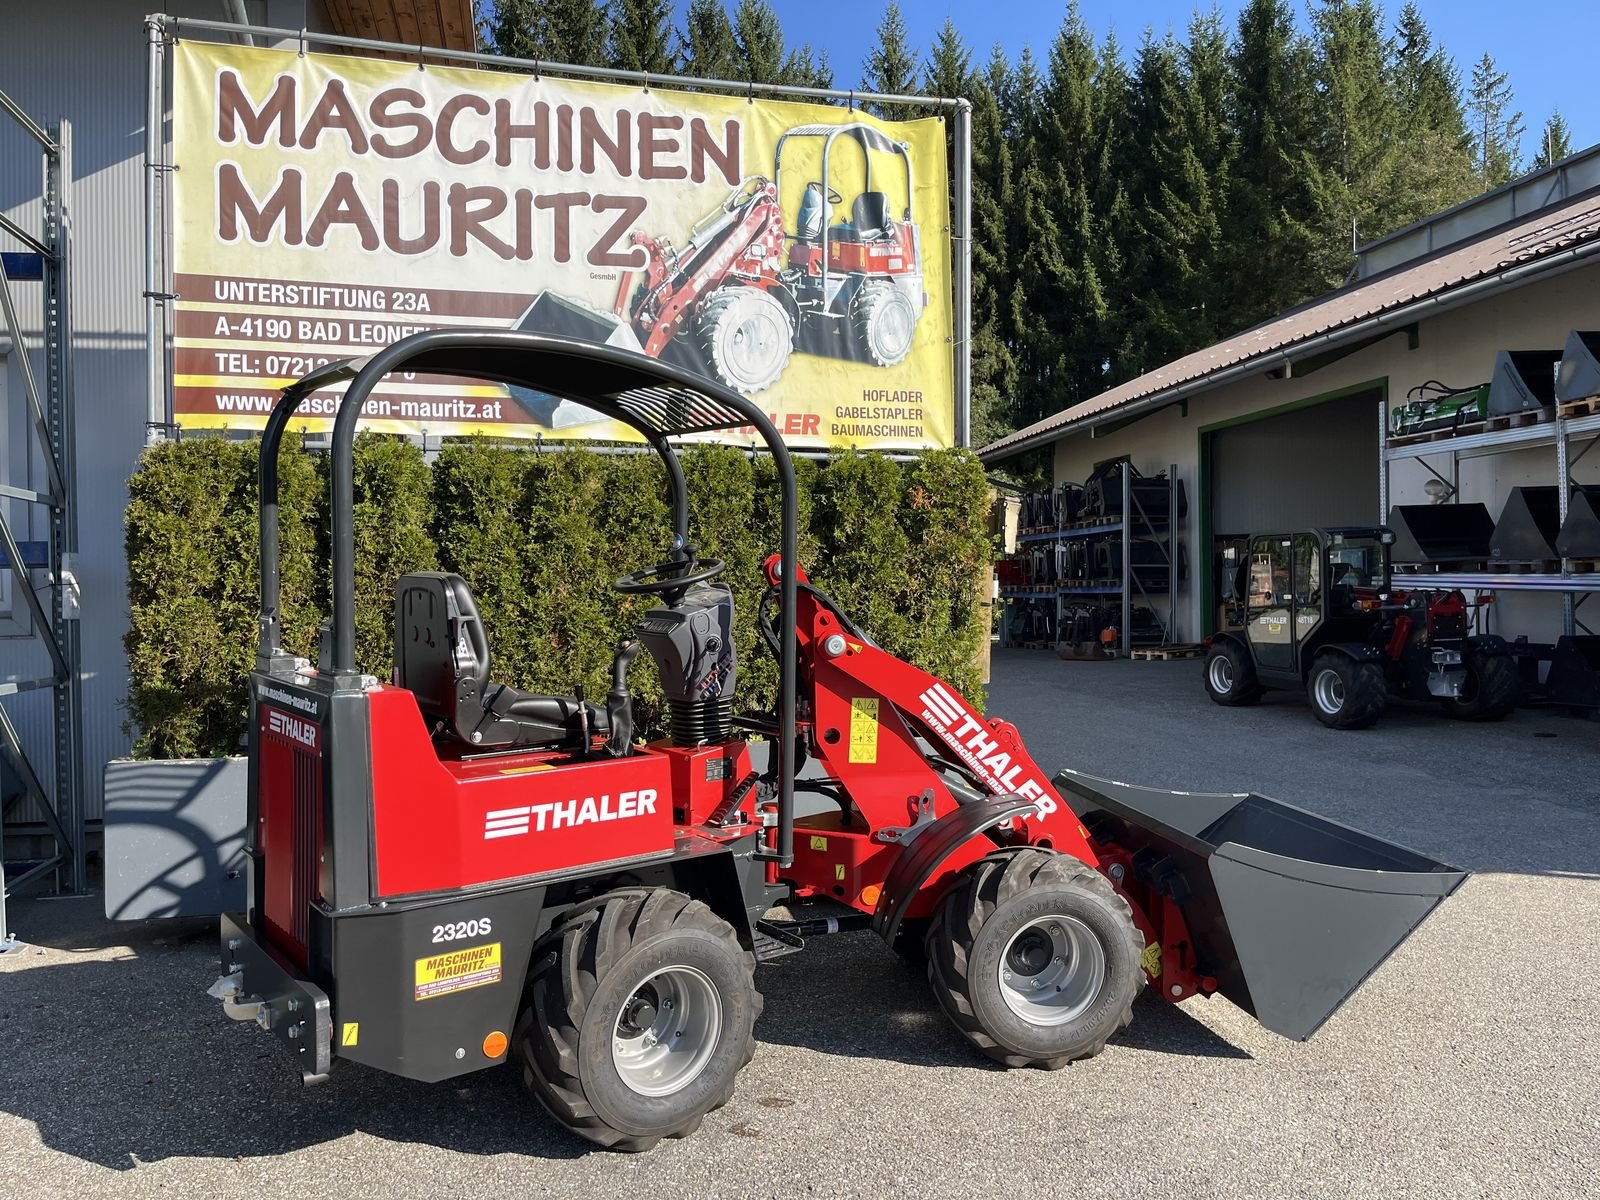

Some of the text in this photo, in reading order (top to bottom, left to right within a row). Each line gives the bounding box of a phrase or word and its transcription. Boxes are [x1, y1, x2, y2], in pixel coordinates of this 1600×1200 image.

[219, 70, 740, 186] MASCHINEN
[219, 163, 648, 268] MAURITZ
[589, 272, 617, 281] GesmbH
[214, 280, 431, 313] UNTERSTIFTUNG 23A
[214, 316, 292, 339] A-4190
[298, 321, 342, 342] BAD
[215, 353, 260, 374] TEL:
[863, 389, 923, 403] HOFLADER
[835, 406, 923, 420] GABELSTAPLER
[831, 423, 923, 438] BAUMASCHINEN
[280, 714, 316, 748] THALER
[954, 713, 1058, 823] THALER
[531, 788, 657, 832] THALER
[431, 917, 492, 943] 2320S
[426, 946, 493, 971] MASCHINEN
[434, 959, 486, 980] MAURITZ
